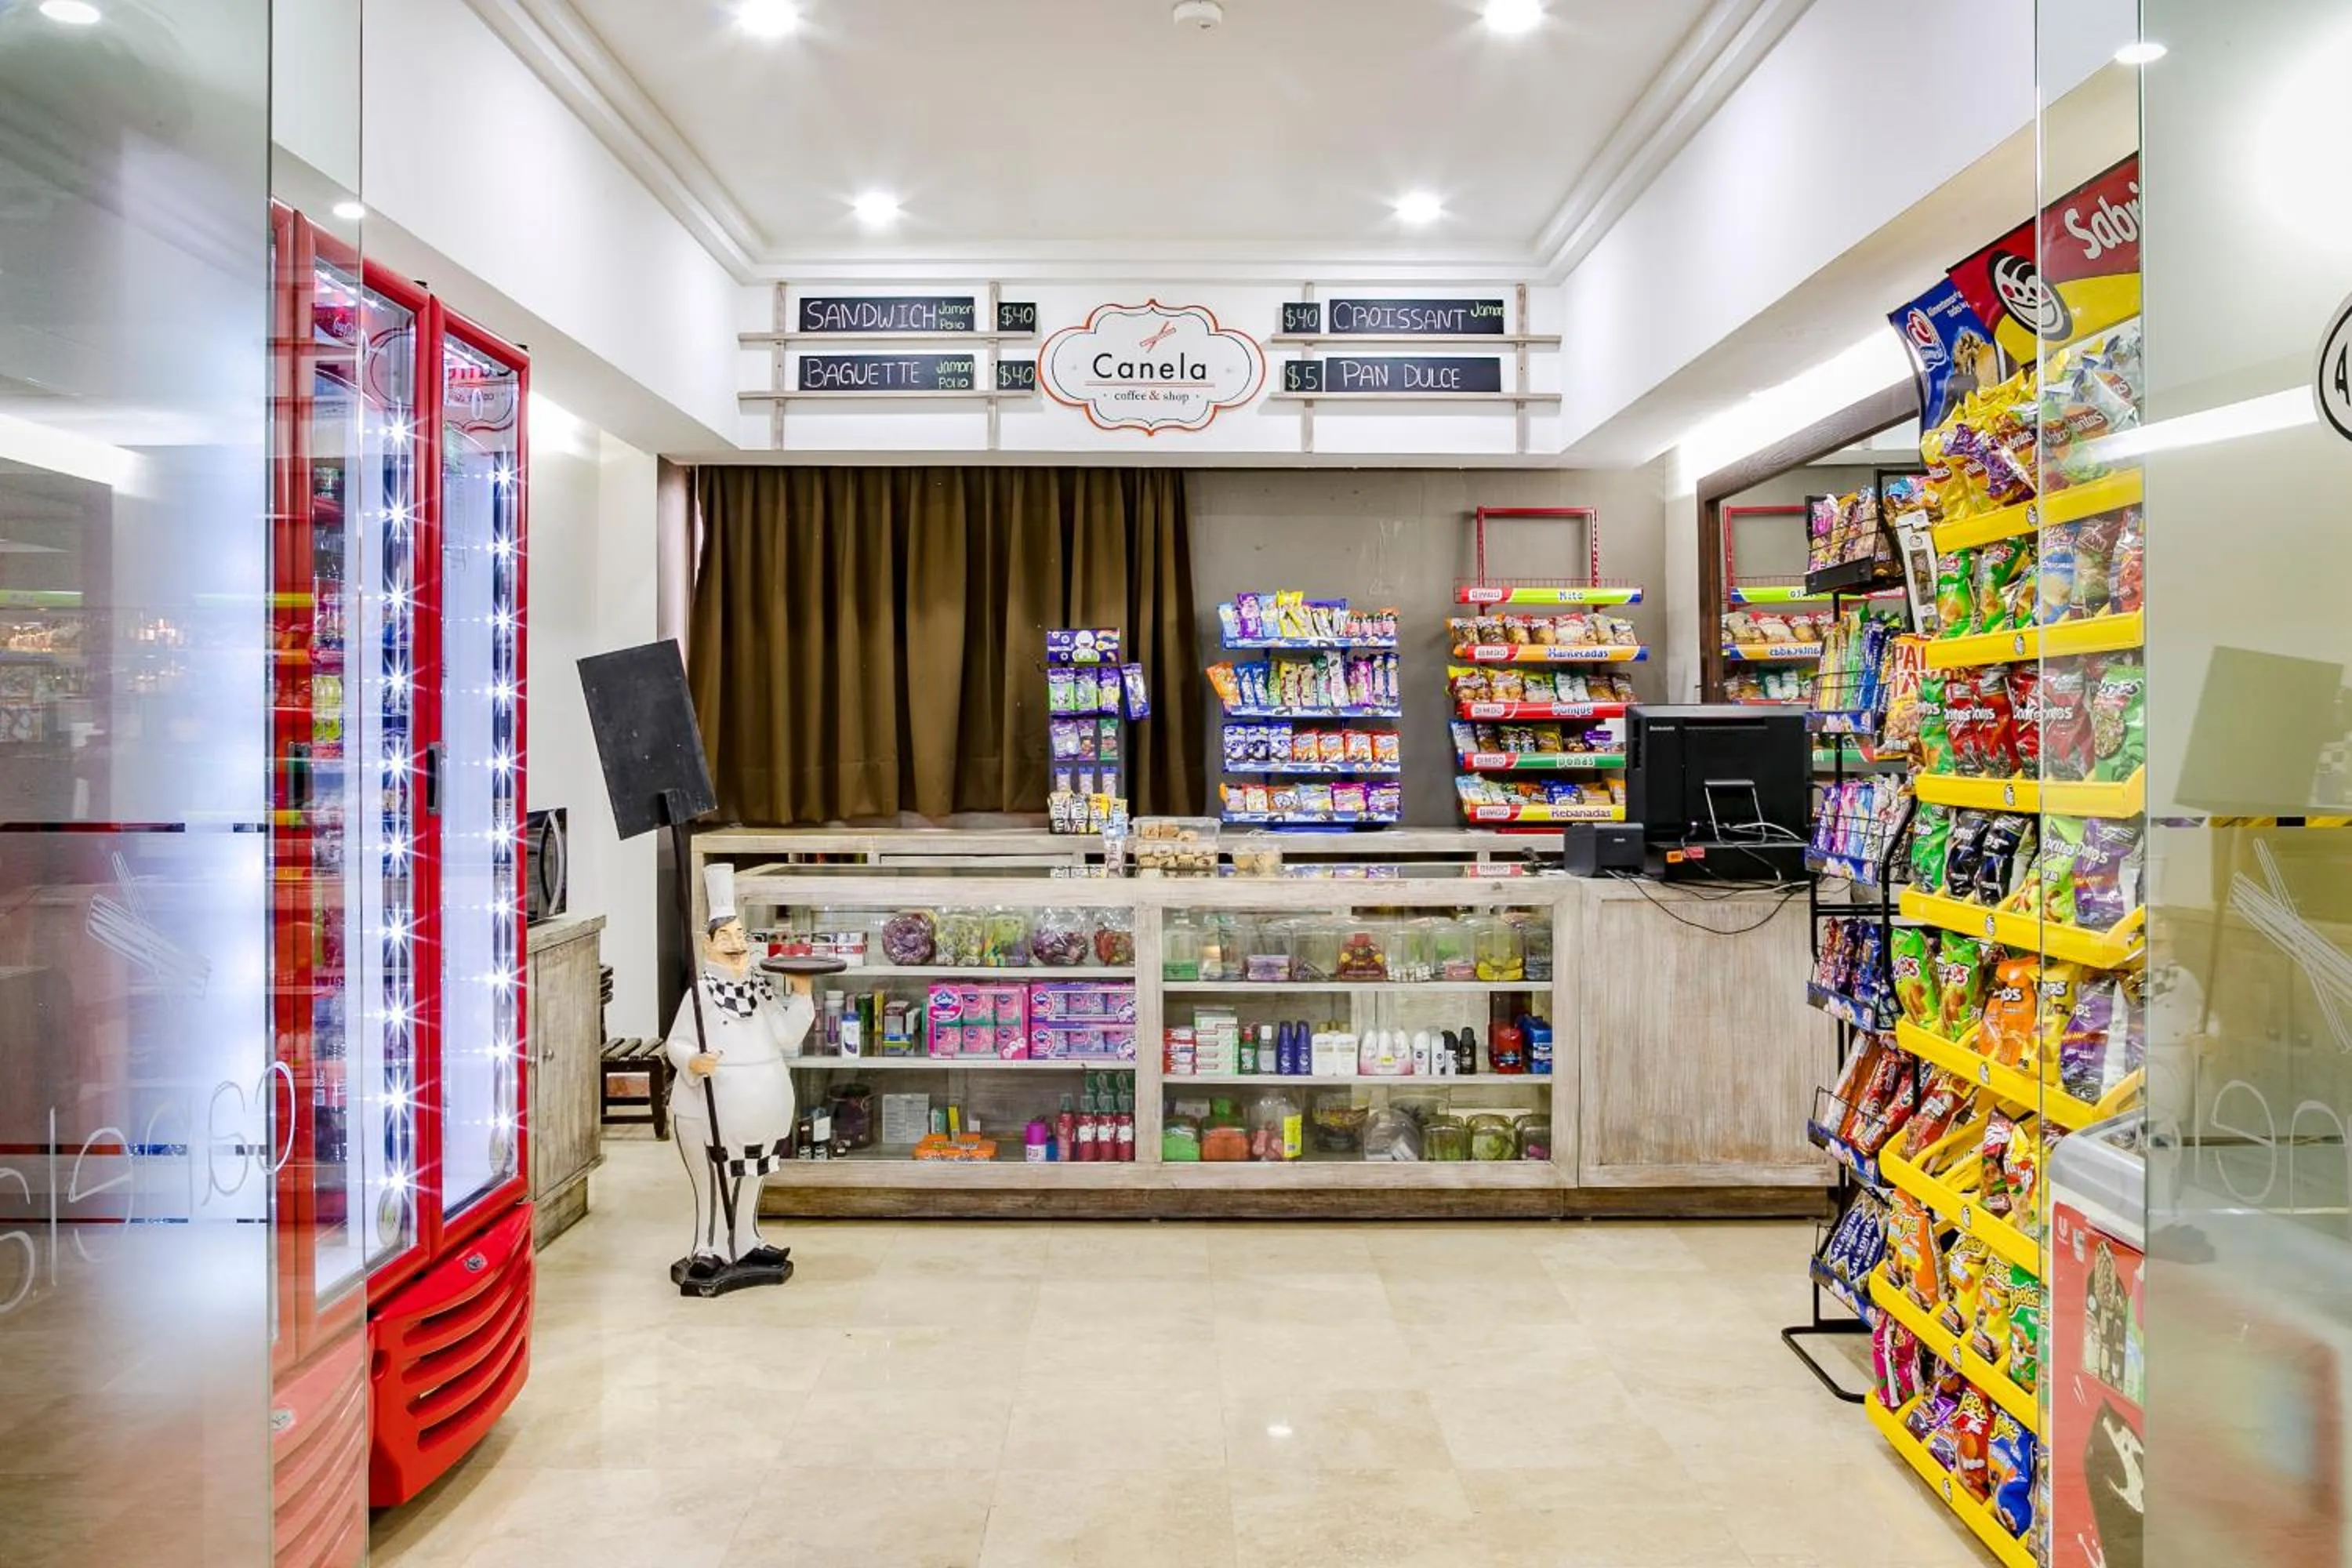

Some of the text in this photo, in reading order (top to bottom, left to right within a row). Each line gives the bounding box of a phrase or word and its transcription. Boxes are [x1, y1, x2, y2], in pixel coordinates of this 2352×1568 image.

[807, 300, 936, 330] SANDWICH
[1001, 304, 1034, 326] $40
[1285, 307, 1318, 330] $40
[1334, 302, 1466, 331] CROISSANT
[804, 358, 920, 388] BAGUETTE
[999, 365, 1034, 387] $40
[1093, 353, 1206, 379] Canela
[1339, 361, 1461, 389] PAN DULCE
[1114, 390, 1189, 405] coffee & shop
